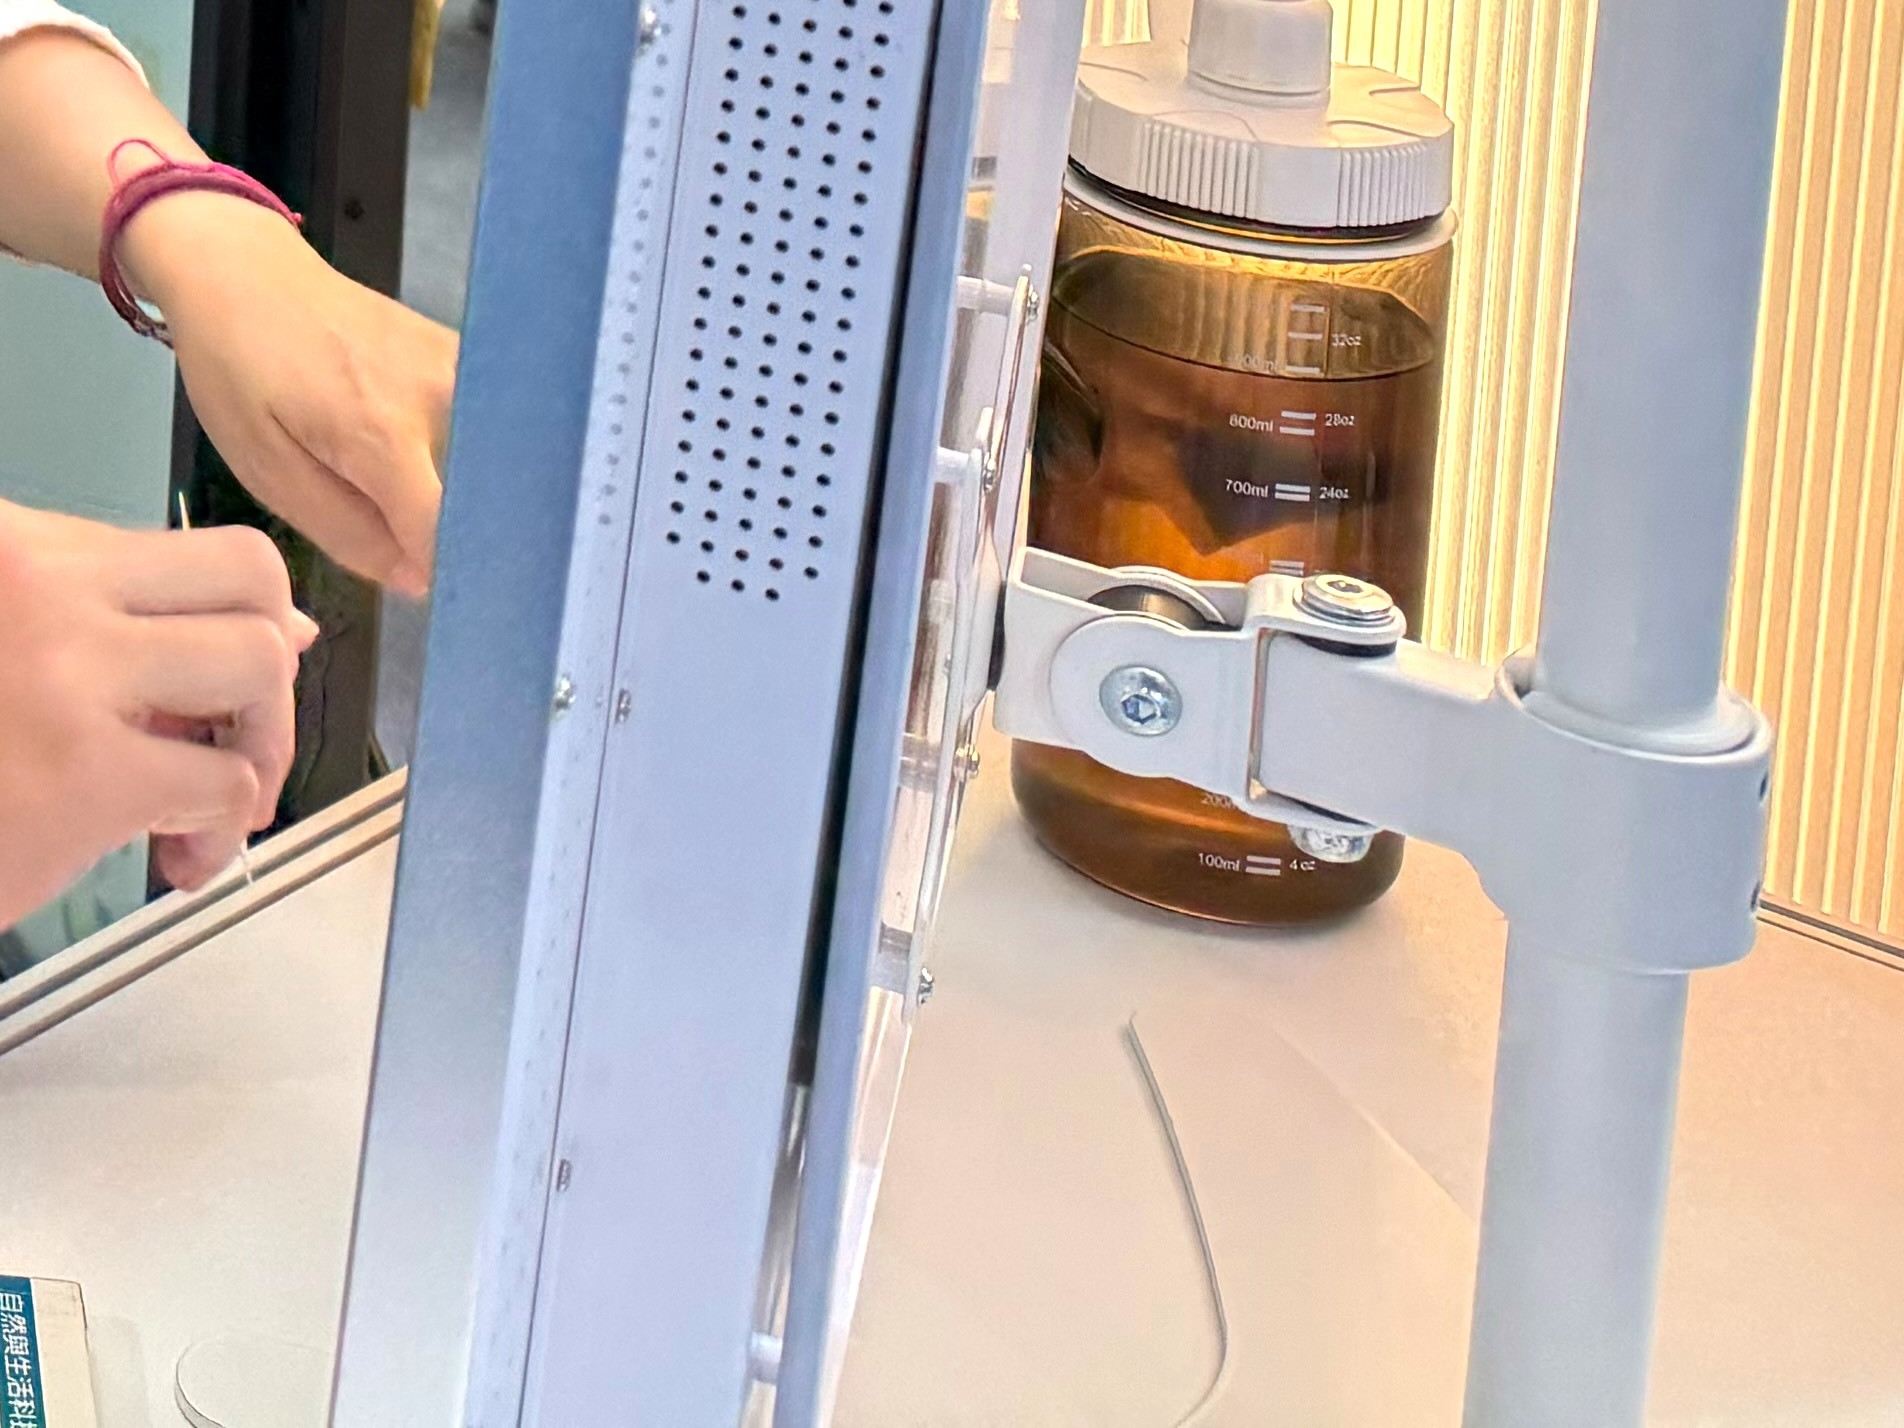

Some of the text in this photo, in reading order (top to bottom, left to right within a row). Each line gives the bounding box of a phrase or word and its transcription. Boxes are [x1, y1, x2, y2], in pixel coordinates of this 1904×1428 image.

[1228, 413, 1355, 433] 800ml 28oz
[1224, 478, 1350, 500] 700ml 24oz
[1200, 794, 1237, 810] 200m
[1197, 851, 1241, 873] 100ml
